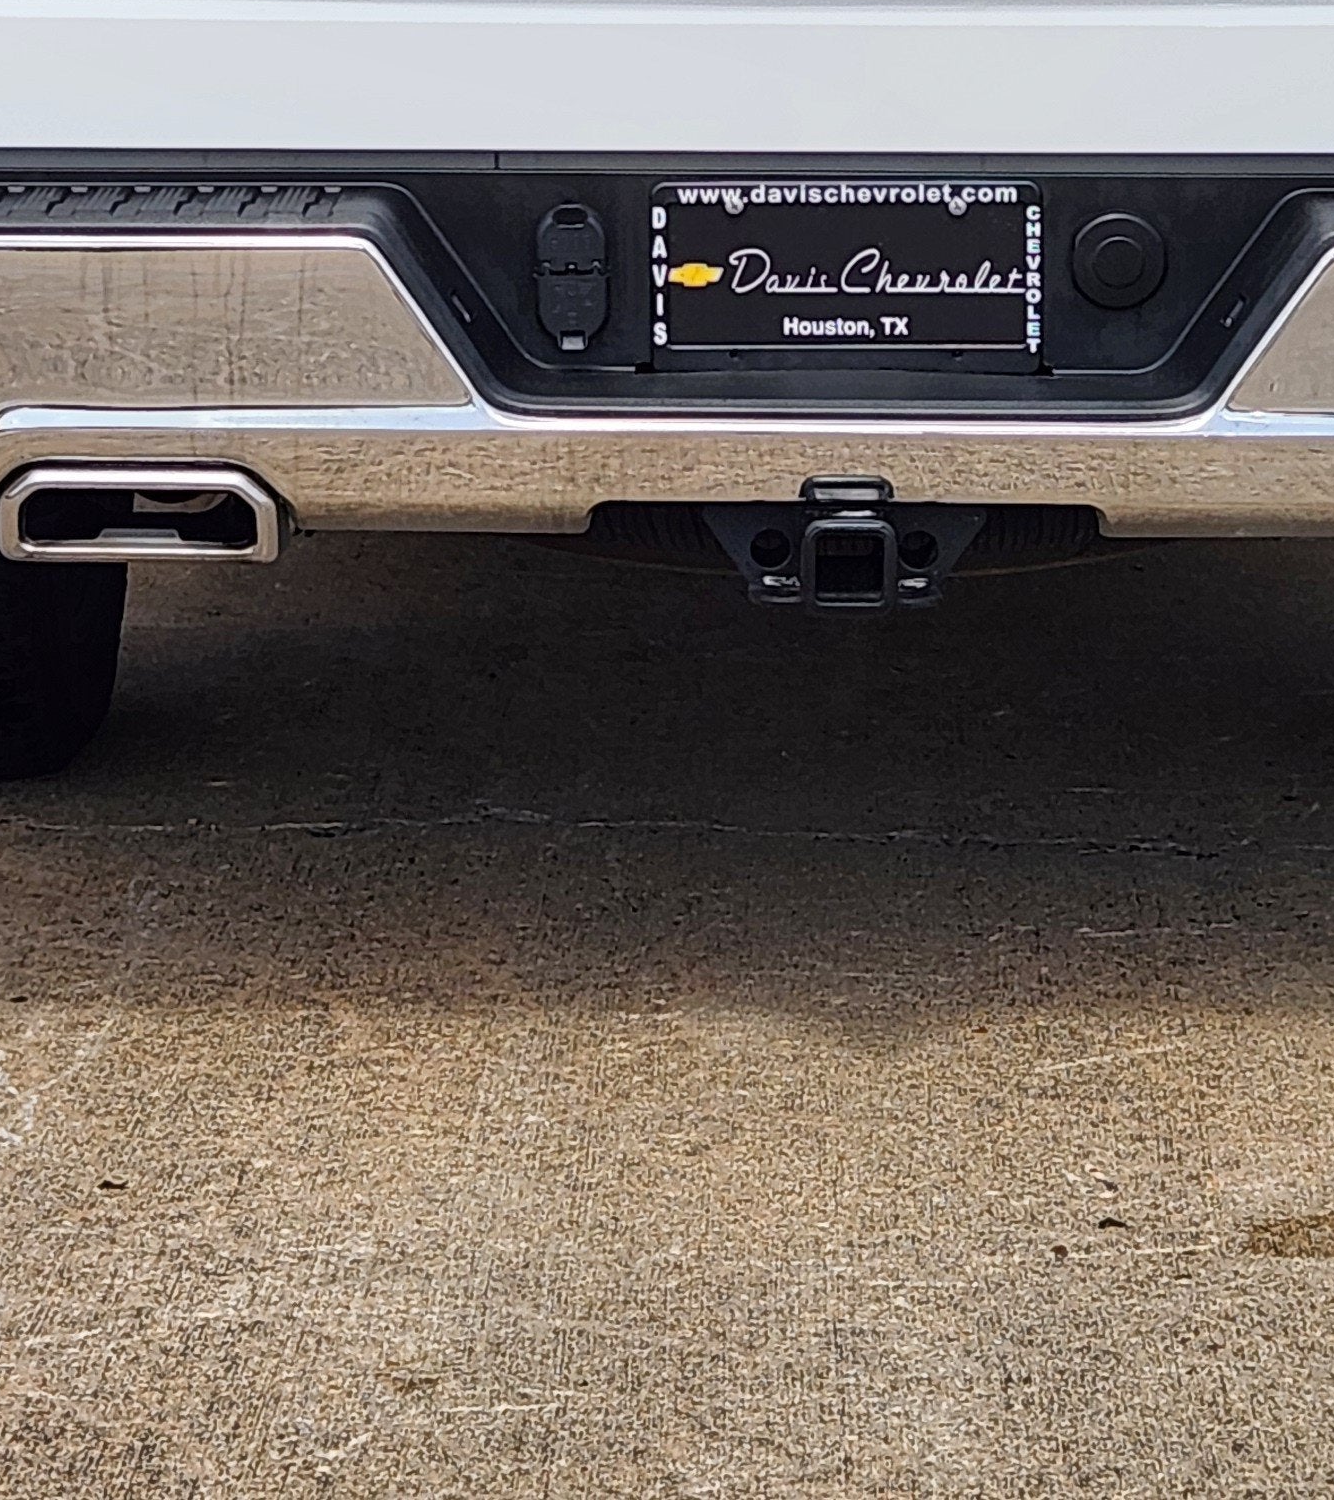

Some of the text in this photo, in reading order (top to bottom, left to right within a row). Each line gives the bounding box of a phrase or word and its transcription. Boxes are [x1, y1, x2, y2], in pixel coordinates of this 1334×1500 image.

[677, 186, 1019, 205] www.davischevrolet.com
[651, 206, 668, 346] DAVIS
[728, 248, 1025, 294] Davis Chevrolet
[1024, 204, 1042, 354] CHEVROLET
[783, 316, 910, 339] Houston, TX
